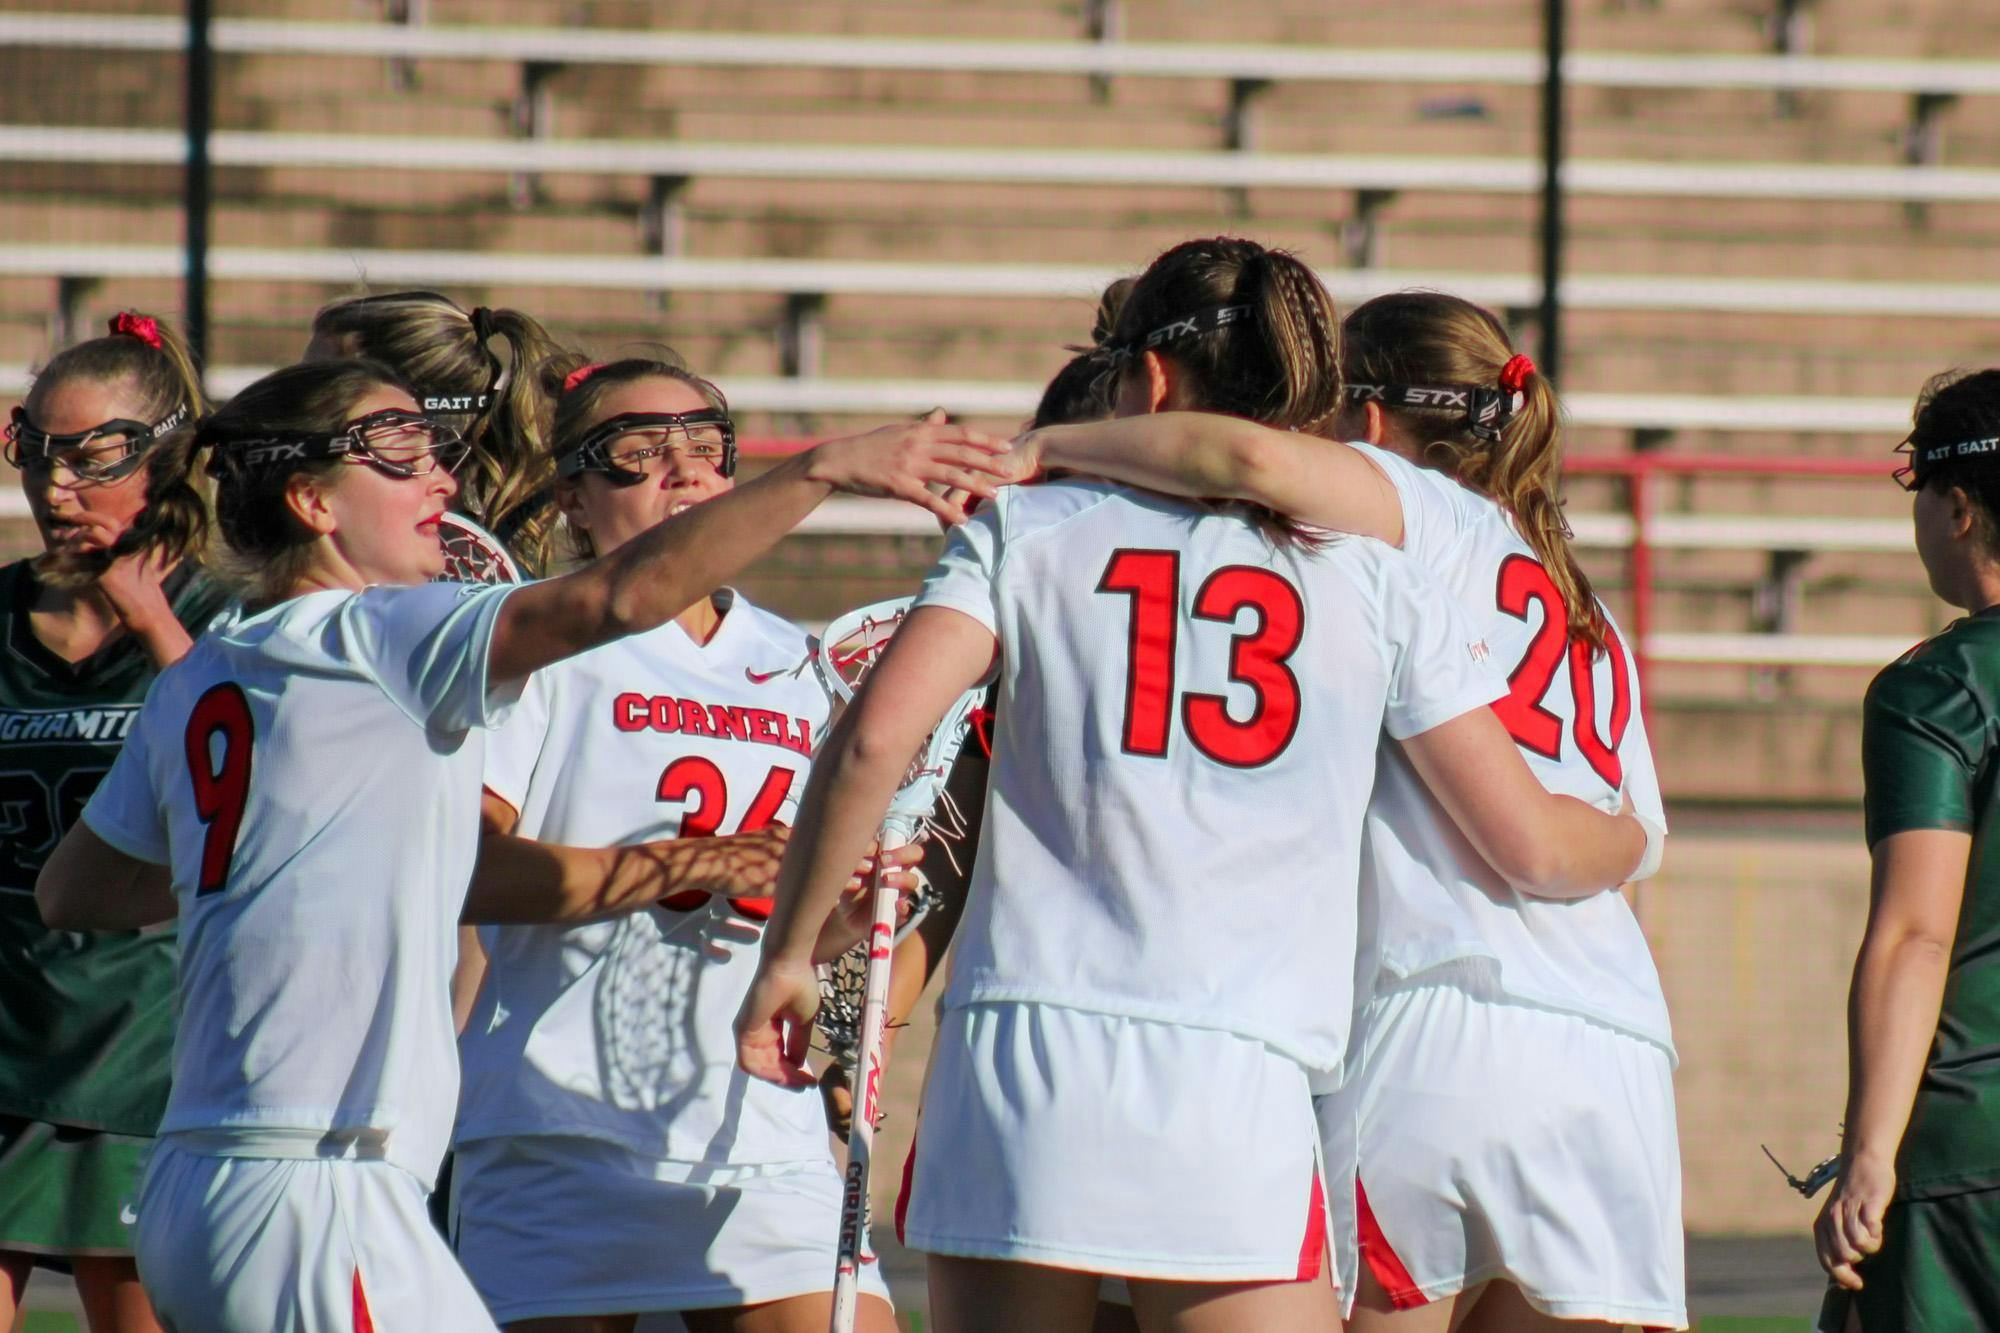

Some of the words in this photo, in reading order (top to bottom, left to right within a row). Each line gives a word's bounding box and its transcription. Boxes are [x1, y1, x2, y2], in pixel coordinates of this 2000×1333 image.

[1147, 316, 1199, 346] STX
[1216, 304, 1256, 326] ST
[423, 396, 472, 410] GAIT
[1343, 383, 1386, 400] TX
[1404, 387, 1468, 407] STX
[244, 441, 307, 465] STX
[1926, 446, 1951, 461] AIT
[1957, 437, 1999, 455] GAIT
[1095, 547, 1305, 769] 13
[1488, 552, 1632, 793] 20
[184, 681, 255, 898] 9
